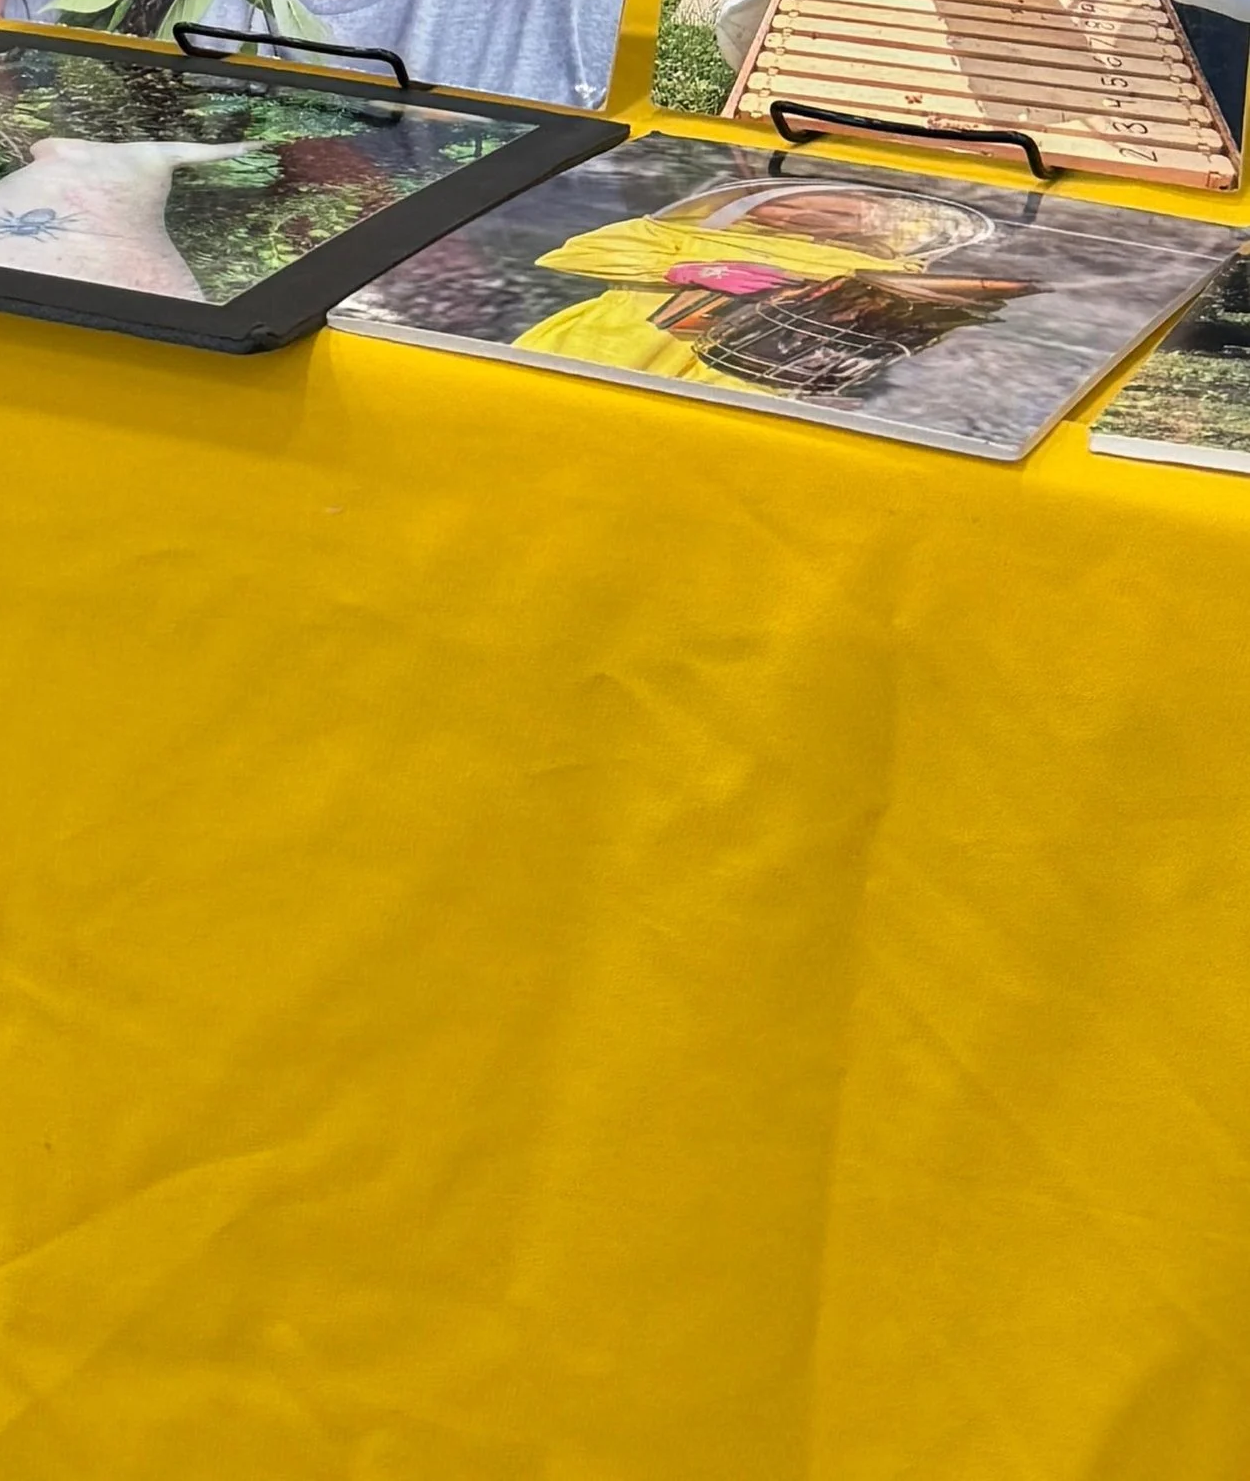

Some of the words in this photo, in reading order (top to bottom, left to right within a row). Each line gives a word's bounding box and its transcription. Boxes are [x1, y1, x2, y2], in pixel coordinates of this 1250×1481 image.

[1101, 75, 1129, 88] 5
[1112, 121, 1148, 135] 3
[1119, 147, 1158, 163] 2
